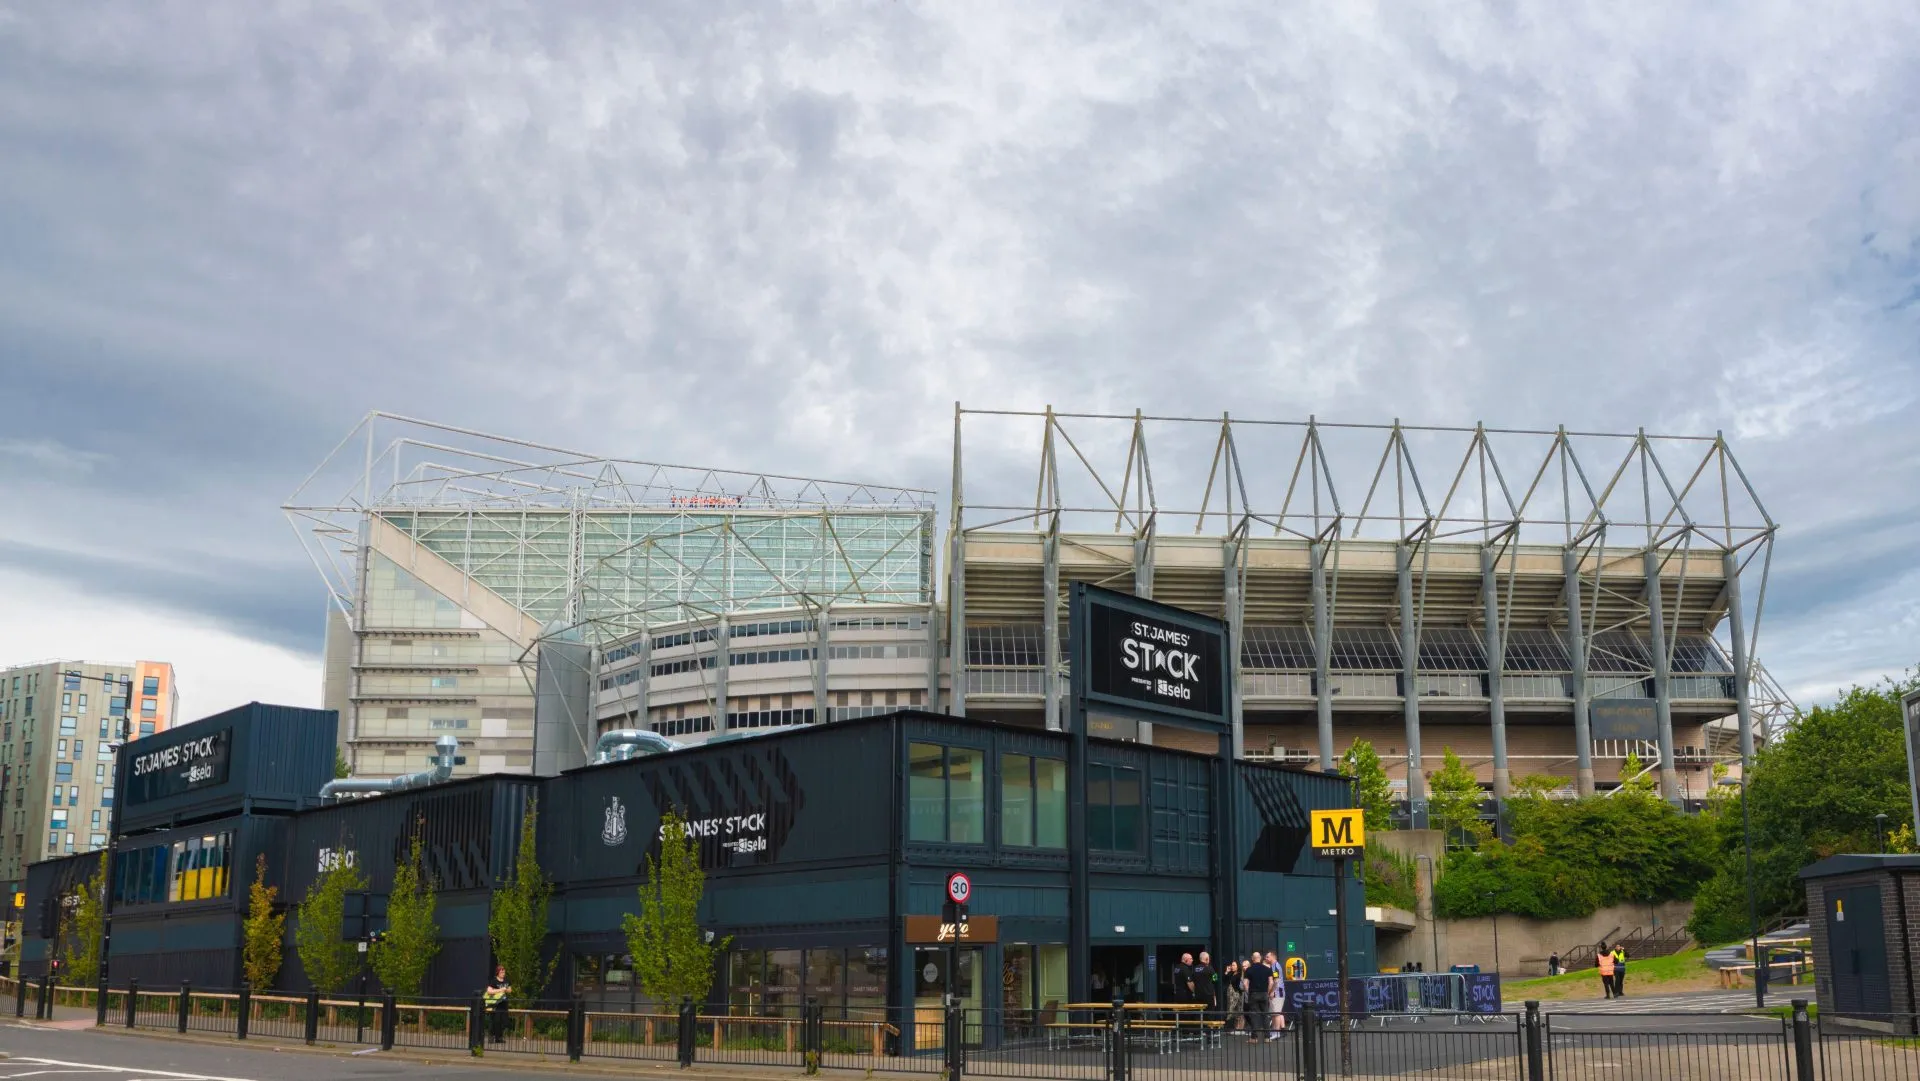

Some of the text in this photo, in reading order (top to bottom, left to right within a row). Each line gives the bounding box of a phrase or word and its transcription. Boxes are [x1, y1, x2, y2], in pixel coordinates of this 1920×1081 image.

[1168, 683, 1191, 700] sela
[1321, 817, 1354, 844] M
[747, 836, 767, 852] sela
[1321, 848, 1355, 856] METRO
[952, 882, 968, 895] 30
[937, 922, 969, 941] yoo
[1293, 990, 1351, 1008] STAC
